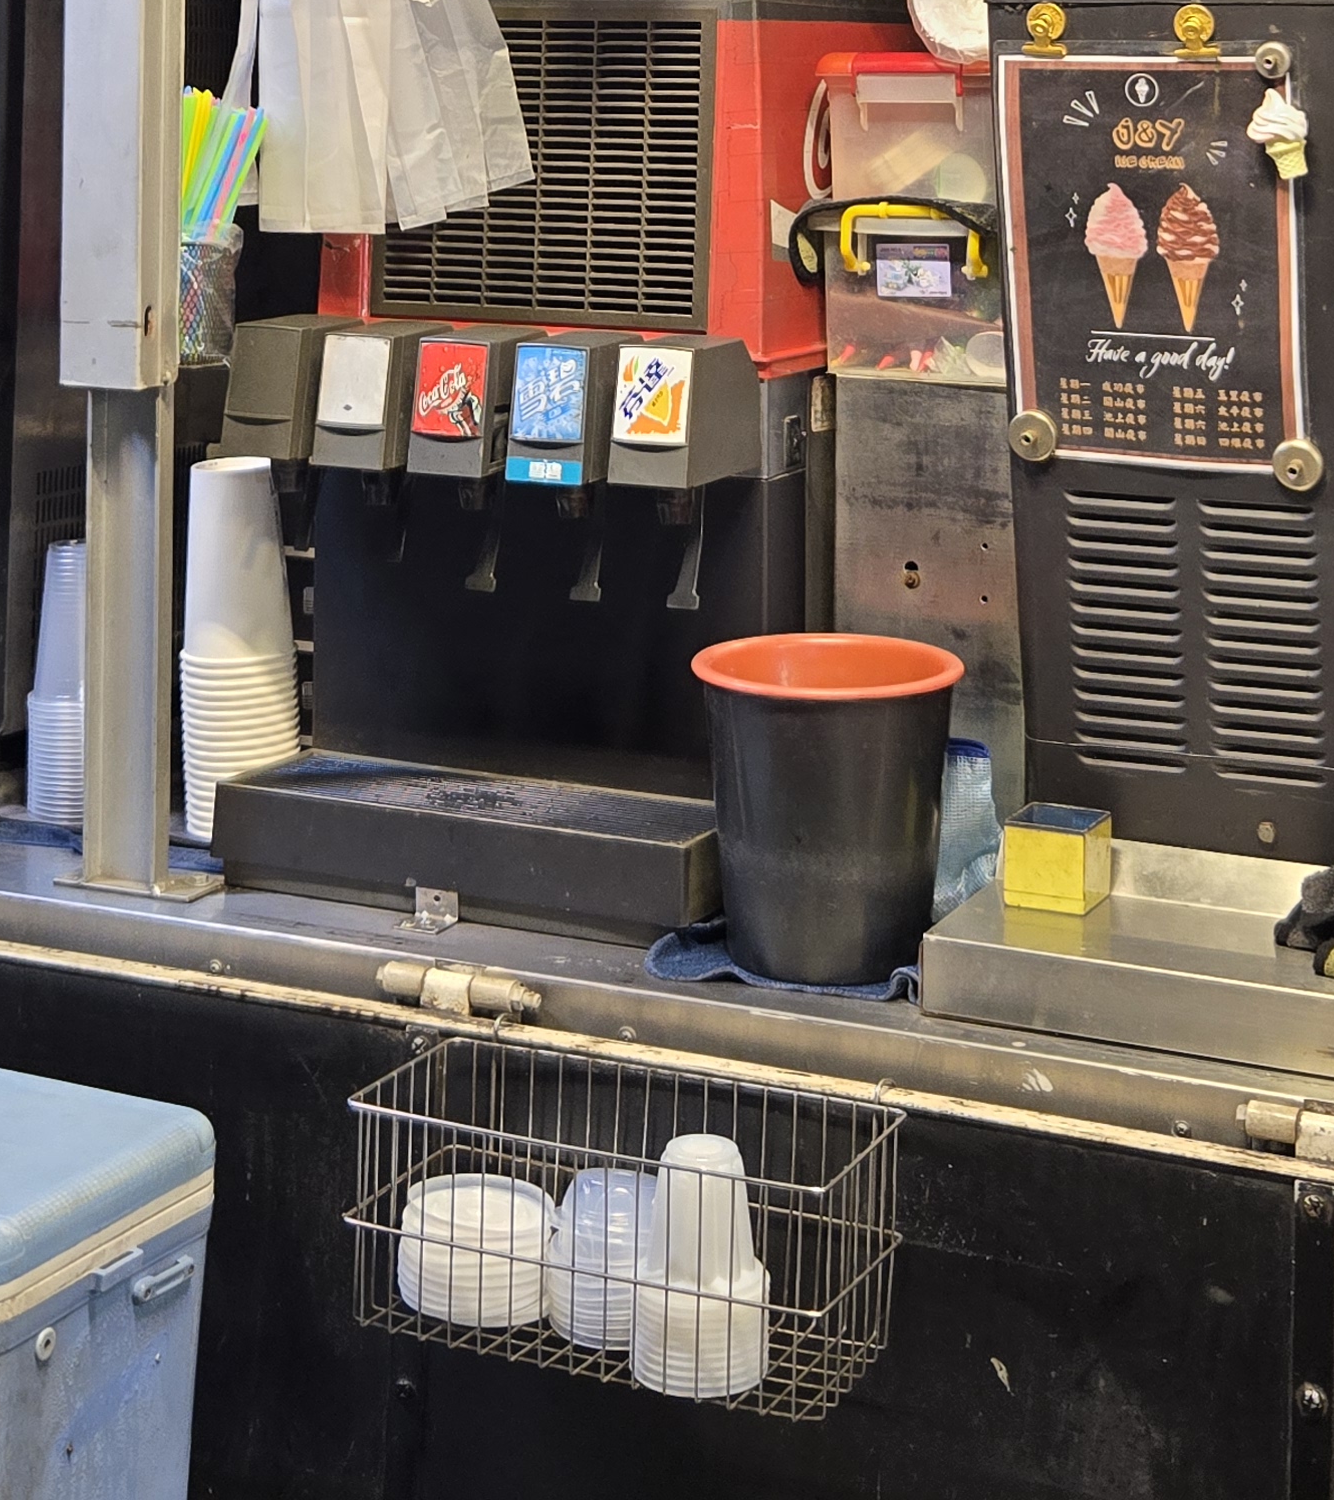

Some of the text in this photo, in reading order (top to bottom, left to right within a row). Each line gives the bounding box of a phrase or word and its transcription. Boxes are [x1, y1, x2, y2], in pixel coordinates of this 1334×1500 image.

[1112, 117, 1186, 152] J&Y
[1085, 338, 1236, 382] Have a good day!
[518, 359, 582, 422] 雪碧
